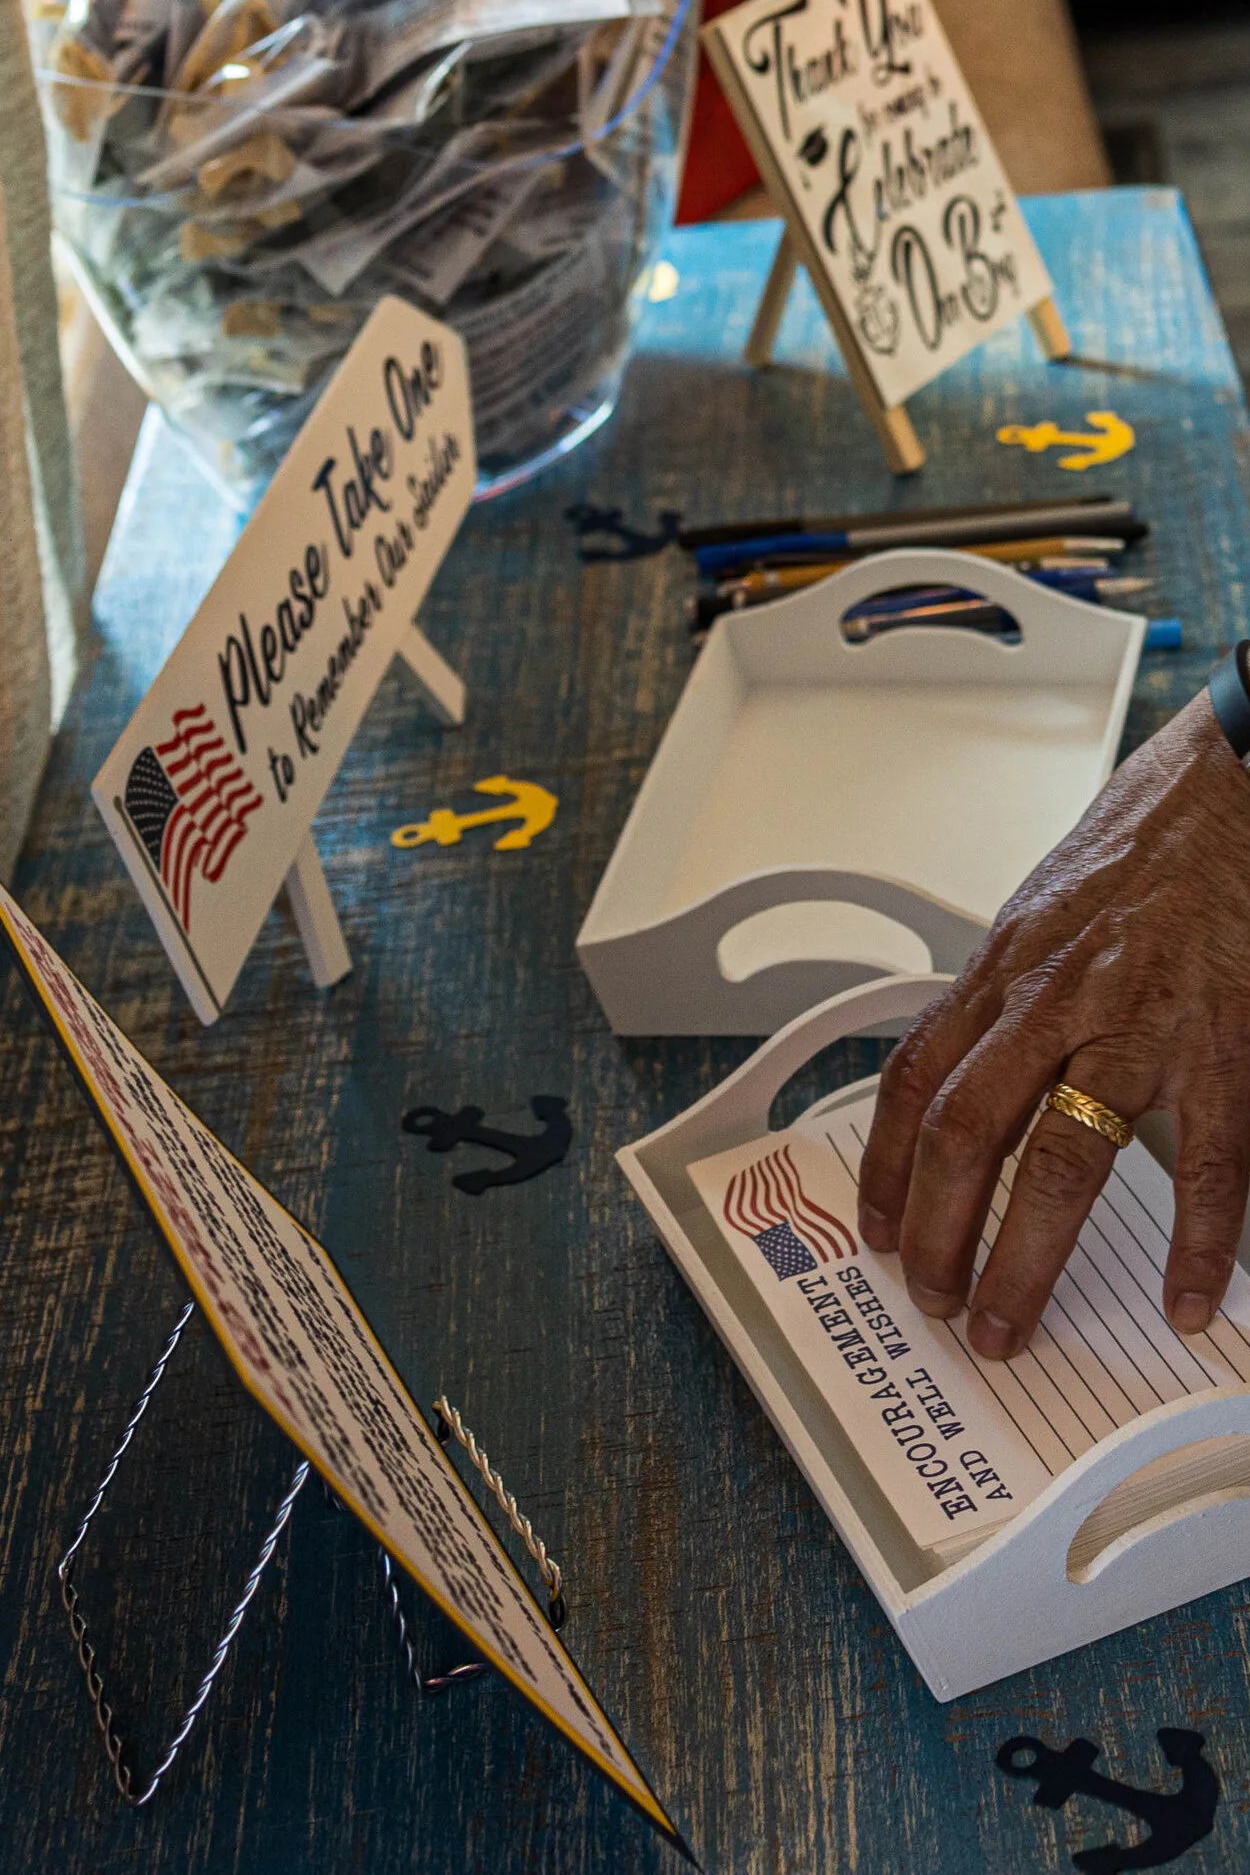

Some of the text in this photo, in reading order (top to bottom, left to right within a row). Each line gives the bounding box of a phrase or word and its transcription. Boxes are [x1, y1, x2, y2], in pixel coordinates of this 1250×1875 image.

[821, 100, 980, 281] Celebrate
[217, 340, 445, 756] Please Take One
[267, 430, 461, 804] to Remember Our Sailor
[796, 1274, 979, 1521] ENCOURAGEMENT
[836, 1265, 1014, 1502] AND WELL WISHES
